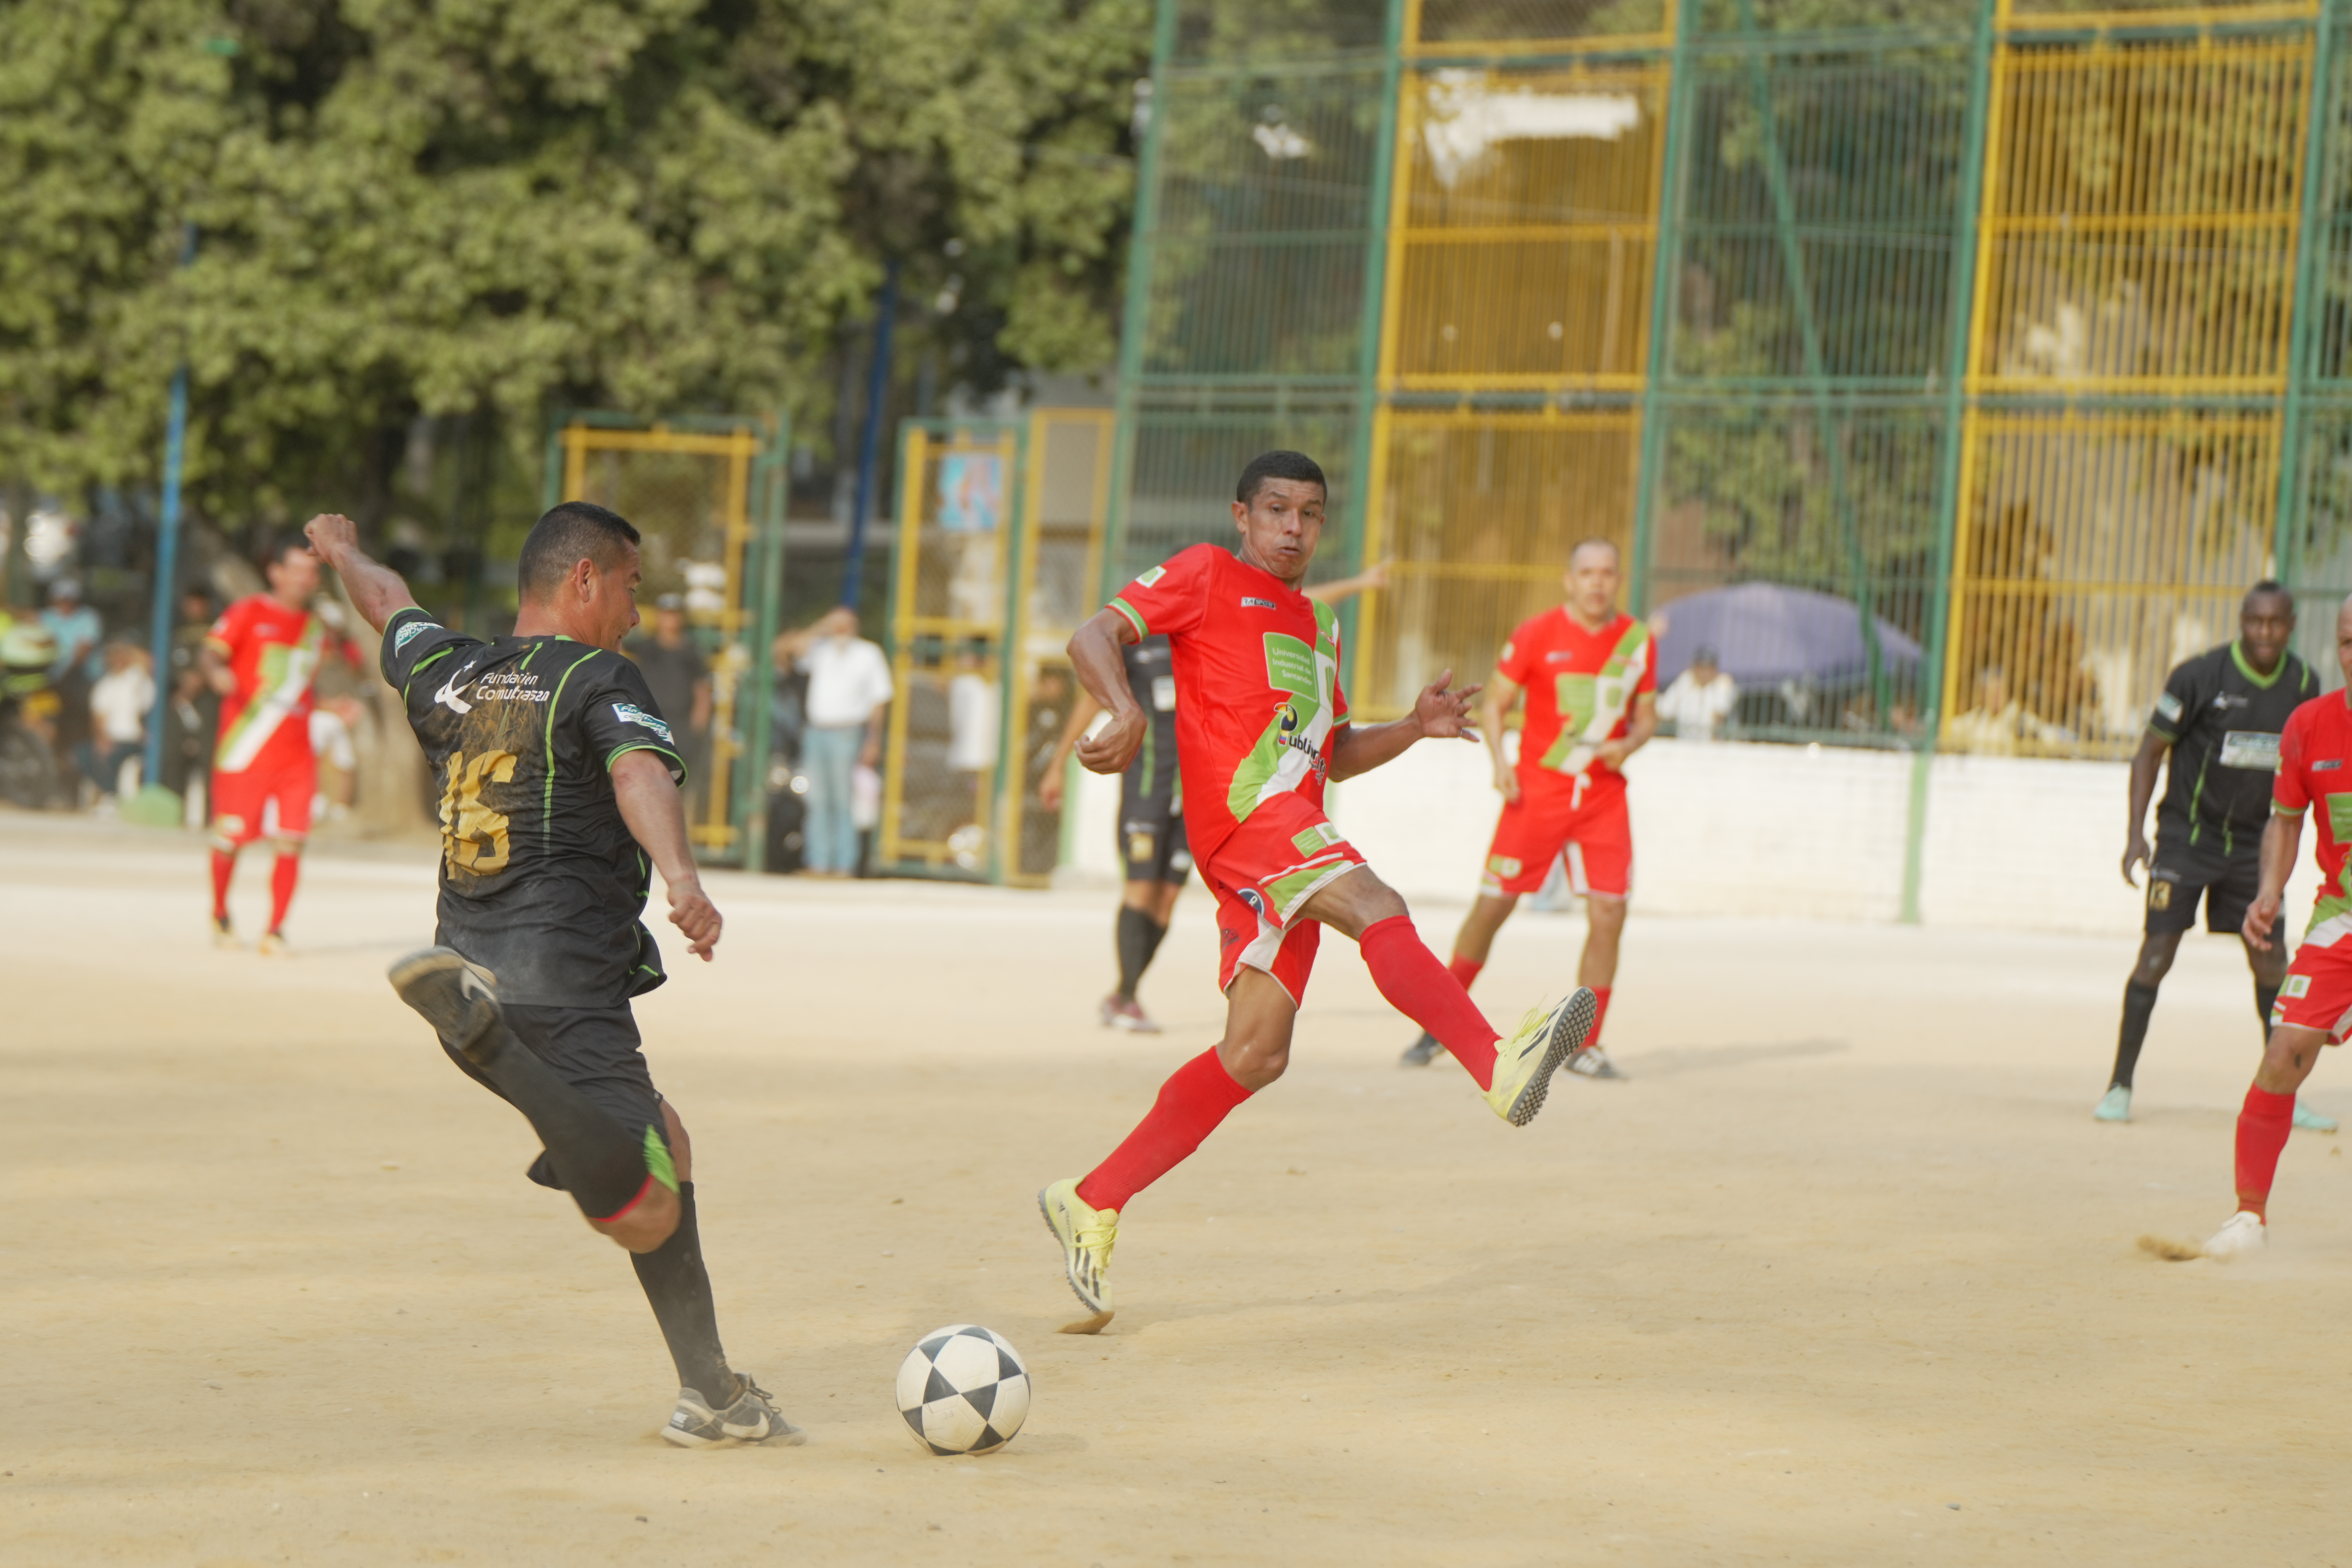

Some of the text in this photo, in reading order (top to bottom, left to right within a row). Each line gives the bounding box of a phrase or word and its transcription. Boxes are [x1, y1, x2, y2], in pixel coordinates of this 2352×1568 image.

[1272, 648, 1310, 665] Universidad
[1272, 658, 1303, 672] Industrial
[1282, 670, 1312, 686] Santander
[439, 749, 517, 880] 16
